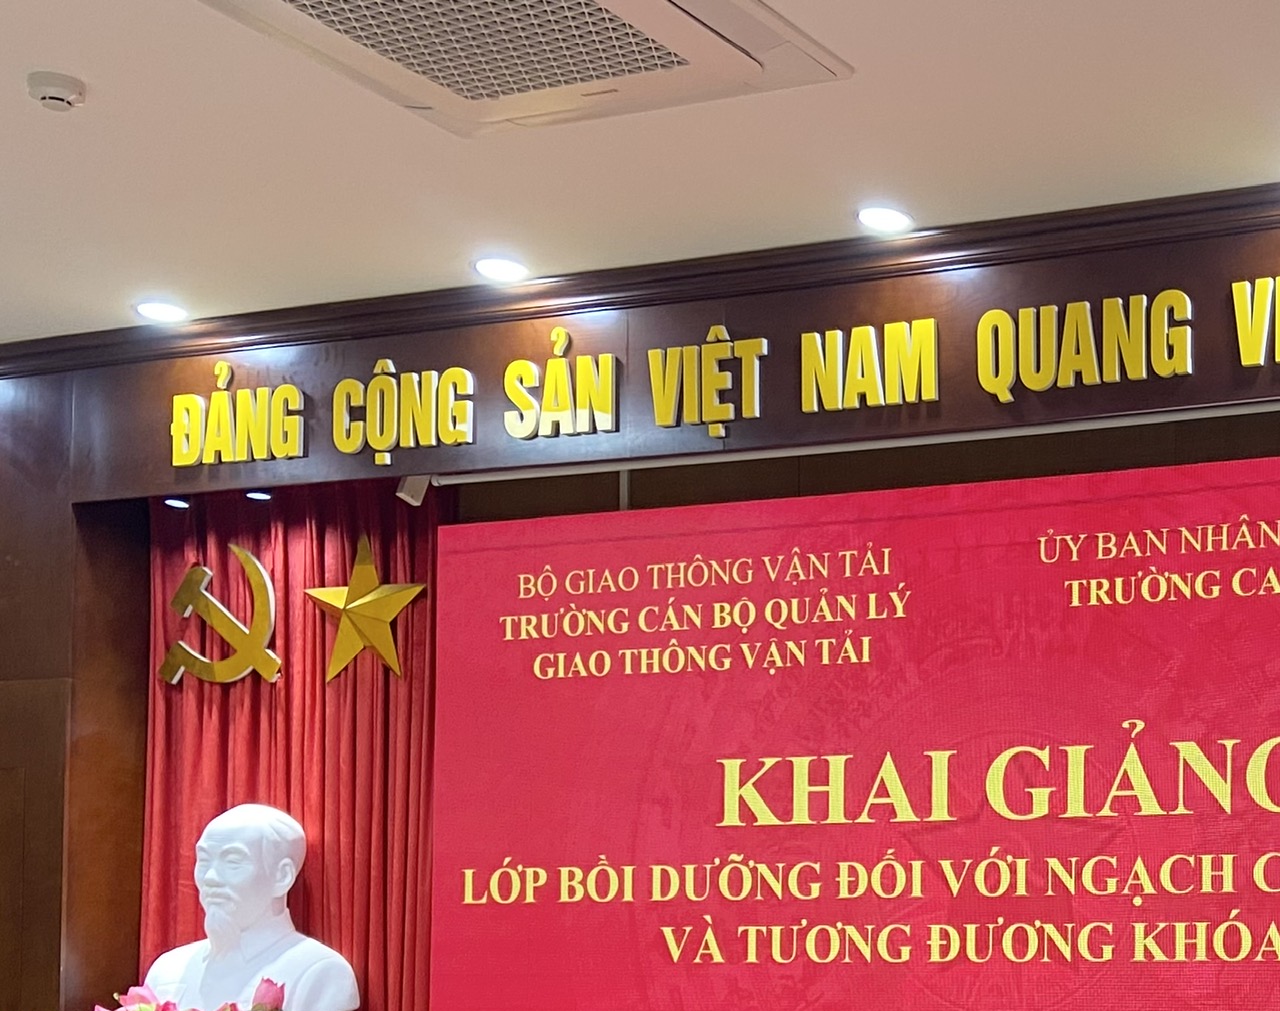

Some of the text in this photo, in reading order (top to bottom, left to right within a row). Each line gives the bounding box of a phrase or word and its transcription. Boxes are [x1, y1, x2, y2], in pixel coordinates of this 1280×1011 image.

[170, 360, 304, 468] ĐẢNG
[332, 359, 474, 466] CỘNG
[503, 326, 615, 440] SẢN
[648, 325, 767, 437] VIỆT
[801, 317, 940, 413] NAM
[976, 289, 1193, 404] QUANG
[518, 541, 892, 601] BỘ GIAO THÔNG VẬN TẢI
[1038, 529, 1087, 563] ỦY
[1096, 528, 1170, 560] BAN
[499, 582, 911, 641] TRƯỜNG CÁN BỘ QUẢN LÝ
[1064, 565, 1221, 607] TRƯỜNG
[533, 629, 872, 680] GIAO THÔNG VẬN TẢI
[715, 749, 957, 827] KHAI
[463, 856, 548, 904] LỚP
[558, 854, 635, 903] BỒI
[650, 853, 822, 902] DƯỠNG
[835, 848, 924, 899] ĐỐI
[938, 846, 1030, 898] VỚI
[1045, 853, 1237, 907] NGẠCH
[660, 914, 725, 963] VÀ
[737, 918, 912, 964] TƯƠNG
[926, 916, 1115, 963] ĐƯƠNG
